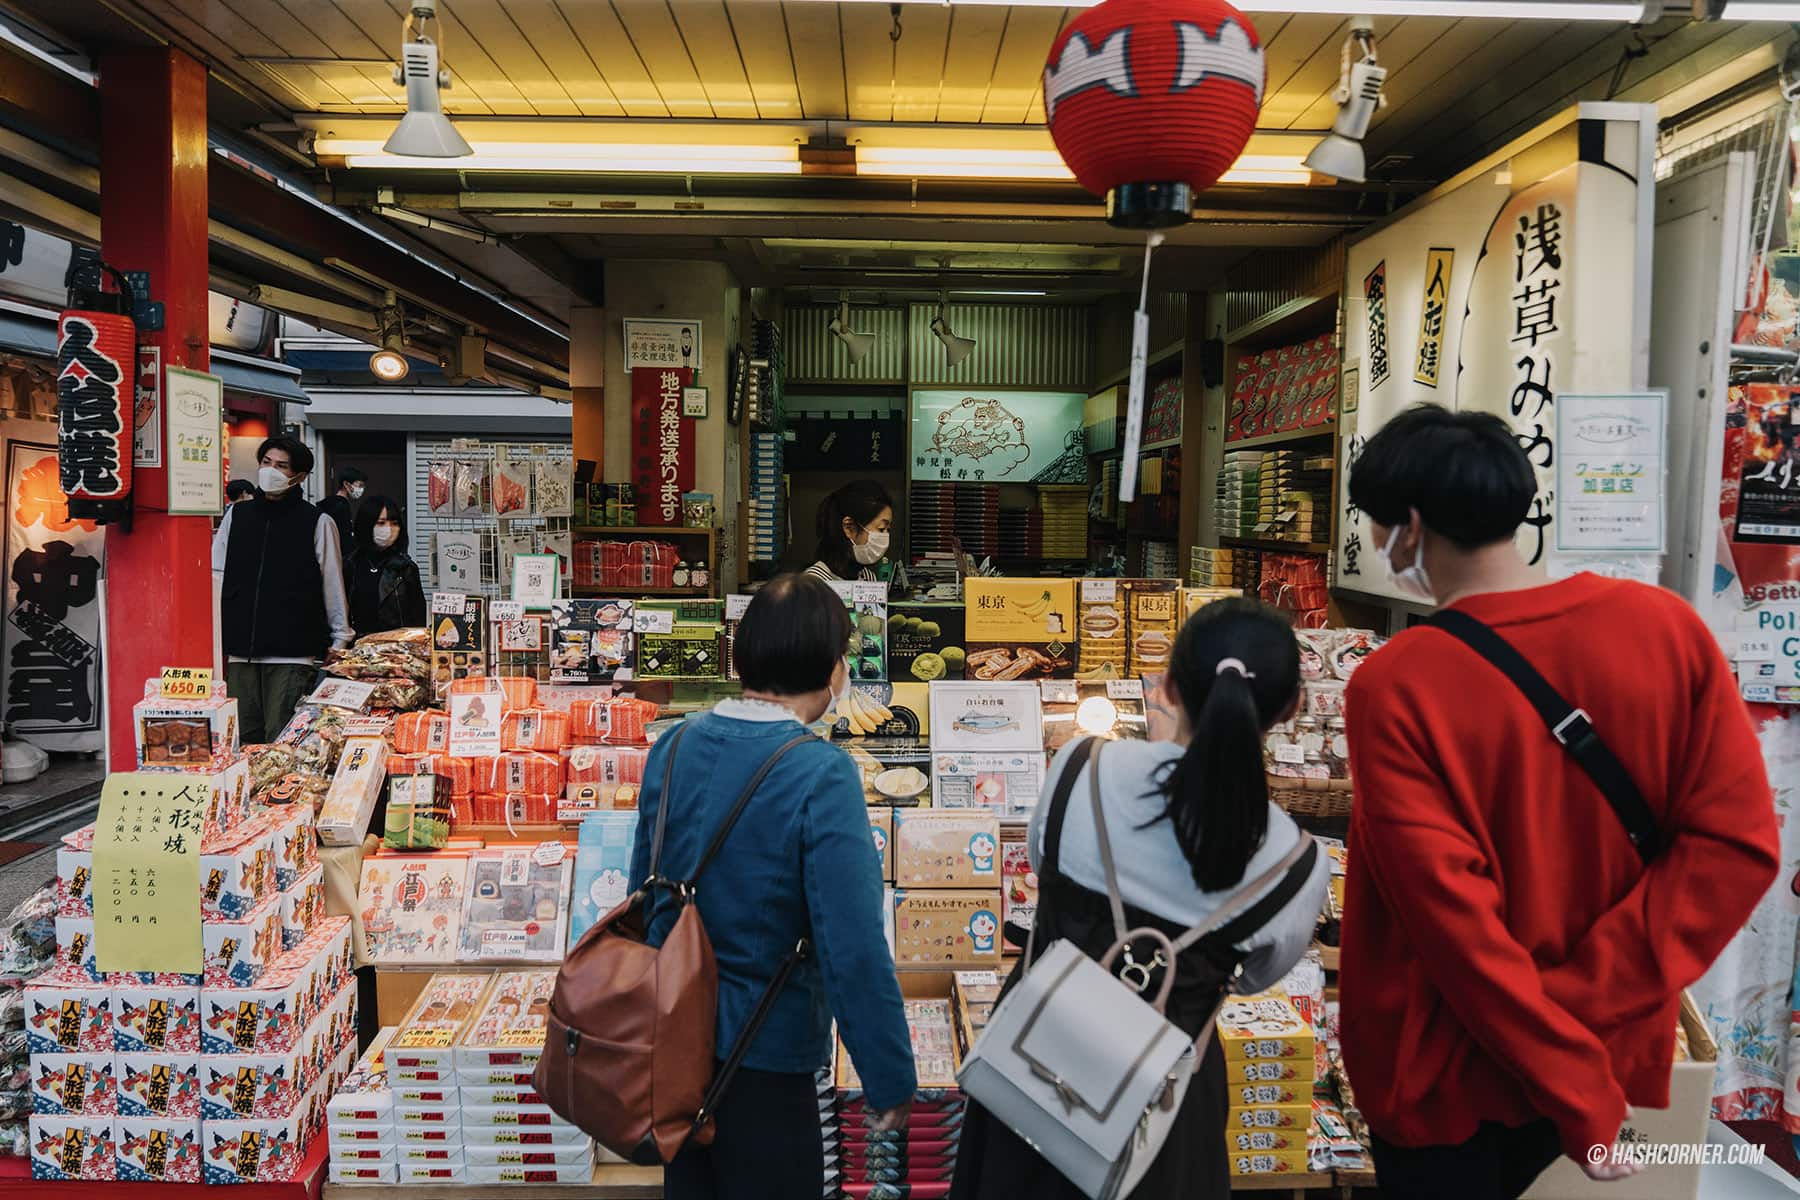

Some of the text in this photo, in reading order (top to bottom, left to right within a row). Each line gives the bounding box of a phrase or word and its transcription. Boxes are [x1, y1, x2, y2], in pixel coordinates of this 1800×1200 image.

[1511, 203, 1561, 565] 浅草みやげ
[178, 433, 213, 448] クーポン
[660, 371, 680, 521] 地方発送承ります
[1576, 463, 1643, 476] クーポン
[1583, 478, 1634, 493] 加盟店
[977, 595, 1006, 609] 東京
[1142, 597, 1168, 612] 東京
[1759, 611, 1800, 630] Pol
[163, 669, 191, 679] 人形焼
[163, 785, 195, 854] 人形焼
[191, 784, 208, 835] 江戸風味
[403, 873, 420, 912] 江戸祭
[58, 1000, 81, 1046] 人形焼
[144, 1000, 167, 1046] 人形焼
[234, 1001, 258, 1048] 人形焼
[63, 1064, 85, 1111] 人形焼
[147, 1064, 170, 1112] 人形焼
[233, 1067, 256, 1114] 人形焼
[61, 1129, 83, 1175] 人形焼
[145, 1129, 168, 1176] 人形焼
[236, 1131, 260, 1177] 人形焼
